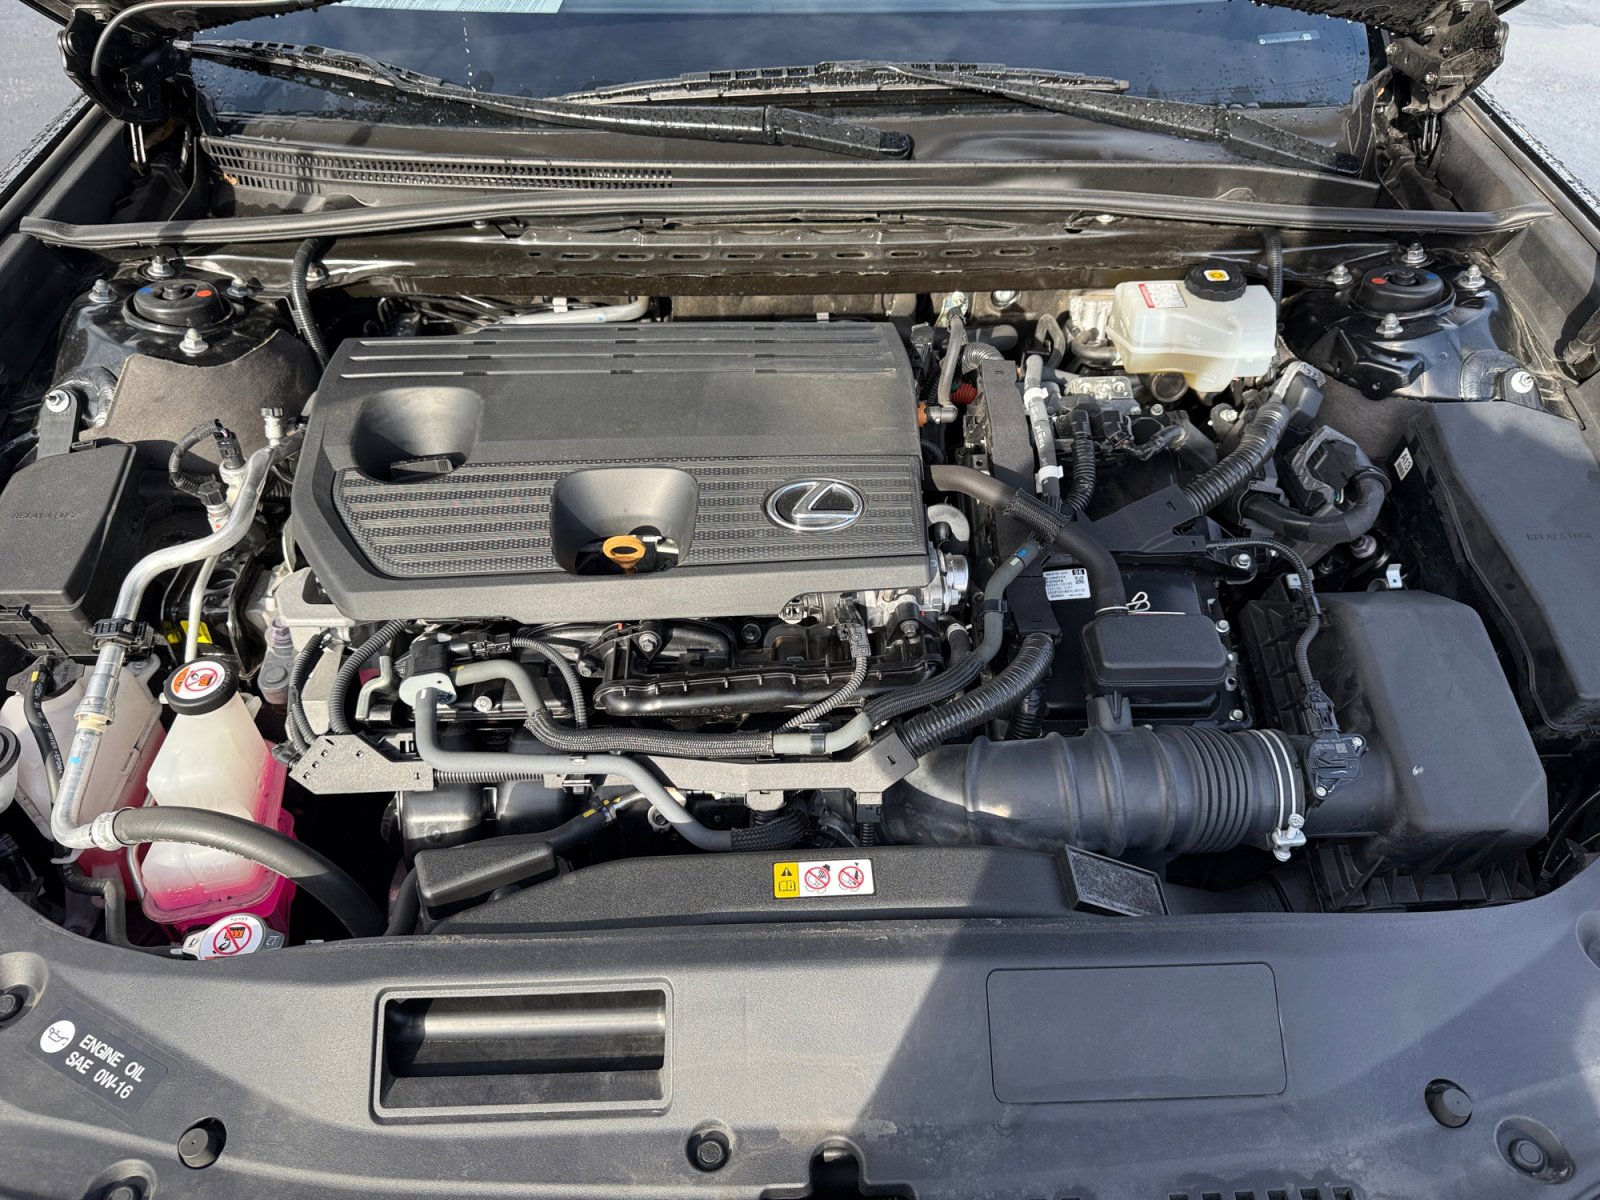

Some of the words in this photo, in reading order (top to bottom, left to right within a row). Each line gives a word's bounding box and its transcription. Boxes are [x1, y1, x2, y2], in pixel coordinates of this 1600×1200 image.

[65, 1051, 94, 1075] SAE
[93, 1068, 134, 1099] 0W-16
[79, 1034, 125, 1068] ENGINE
[124, 1061, 146, 1083] OIL
